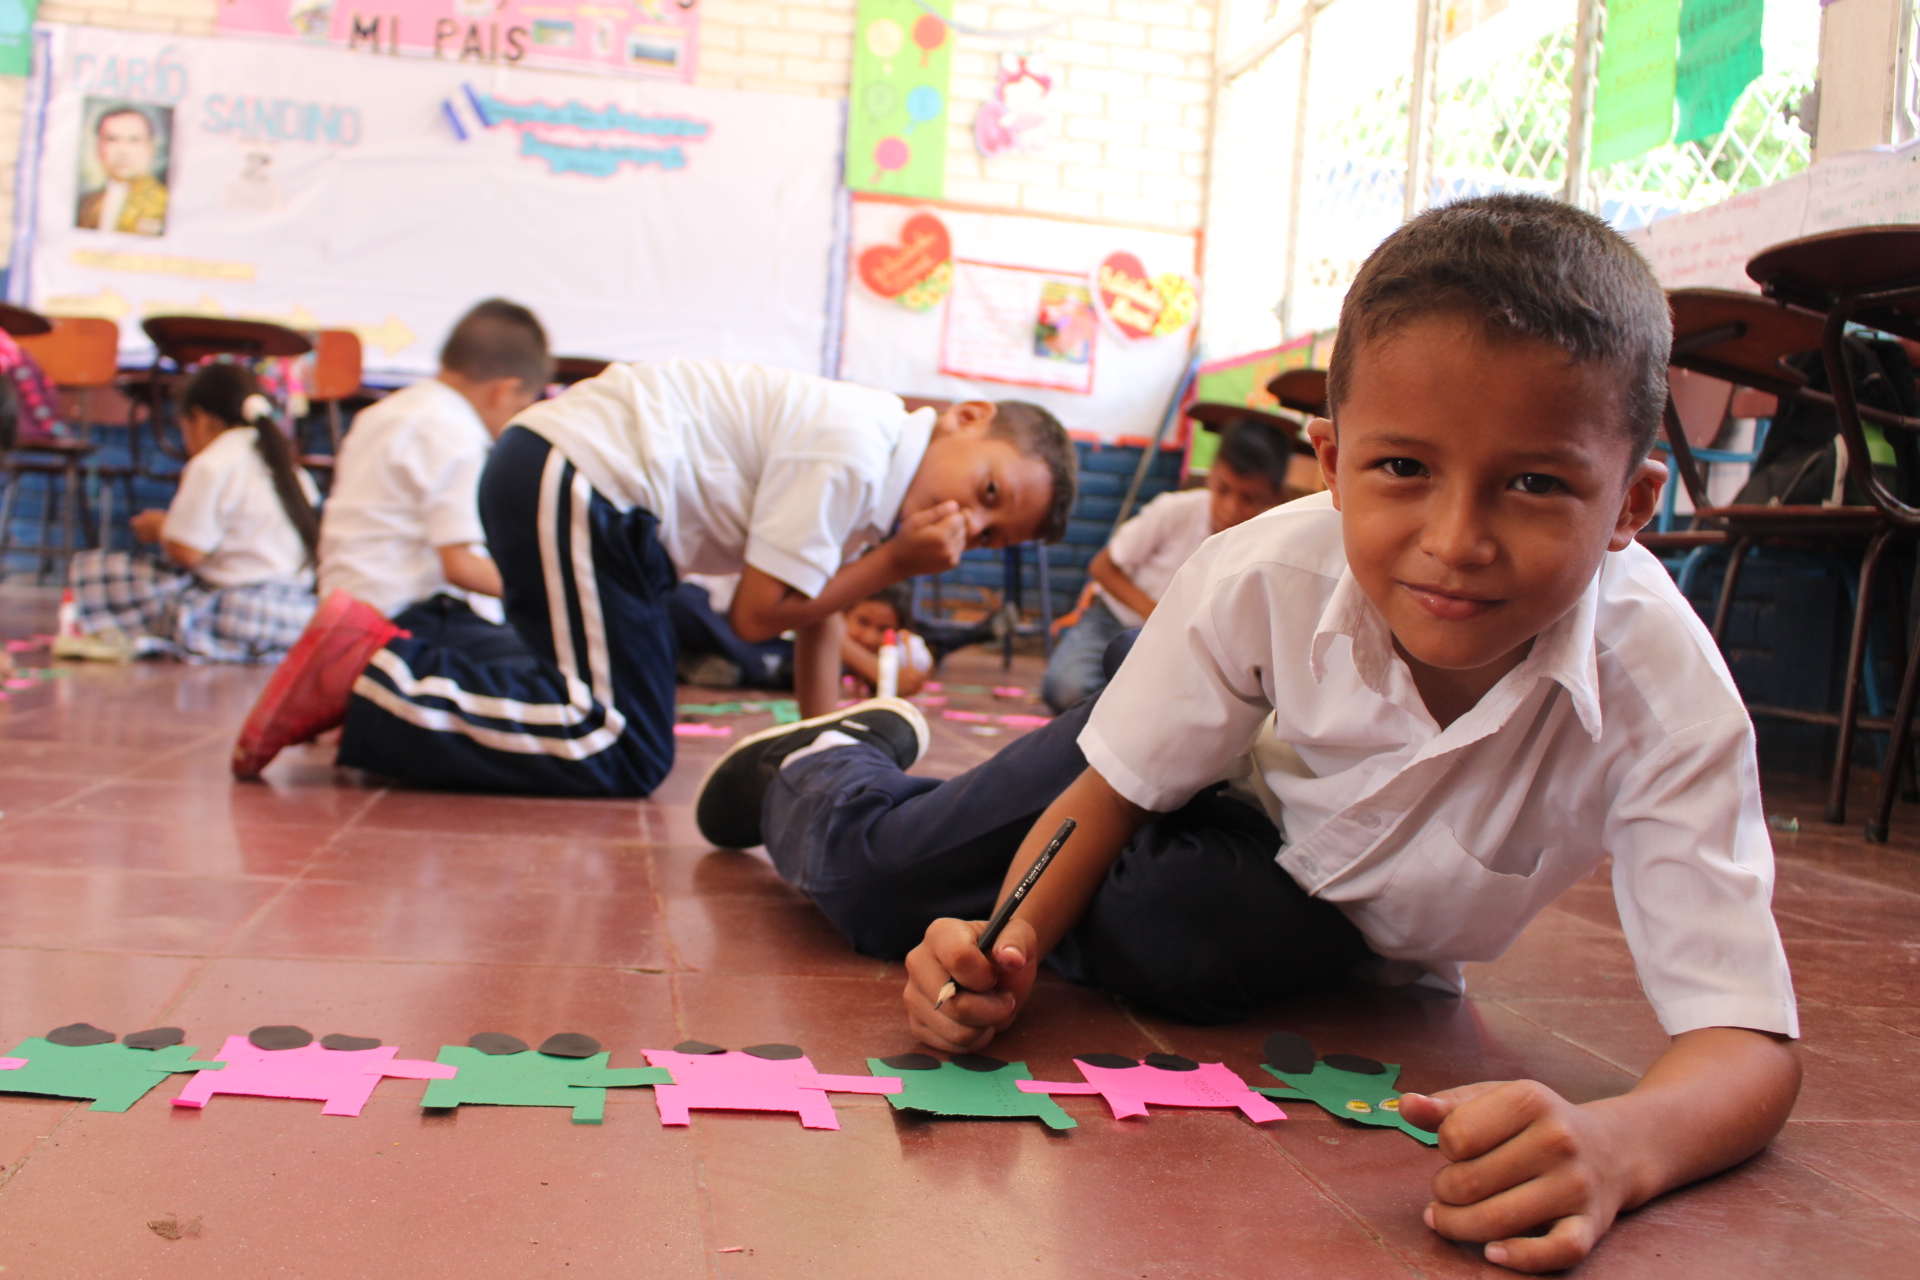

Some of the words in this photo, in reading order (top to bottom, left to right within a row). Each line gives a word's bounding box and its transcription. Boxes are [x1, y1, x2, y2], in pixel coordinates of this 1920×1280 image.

[348, 13, 400, 56] MI
[434, 18, 529, 63] PAIS
[200, 94, 363, 147] SANDINO
